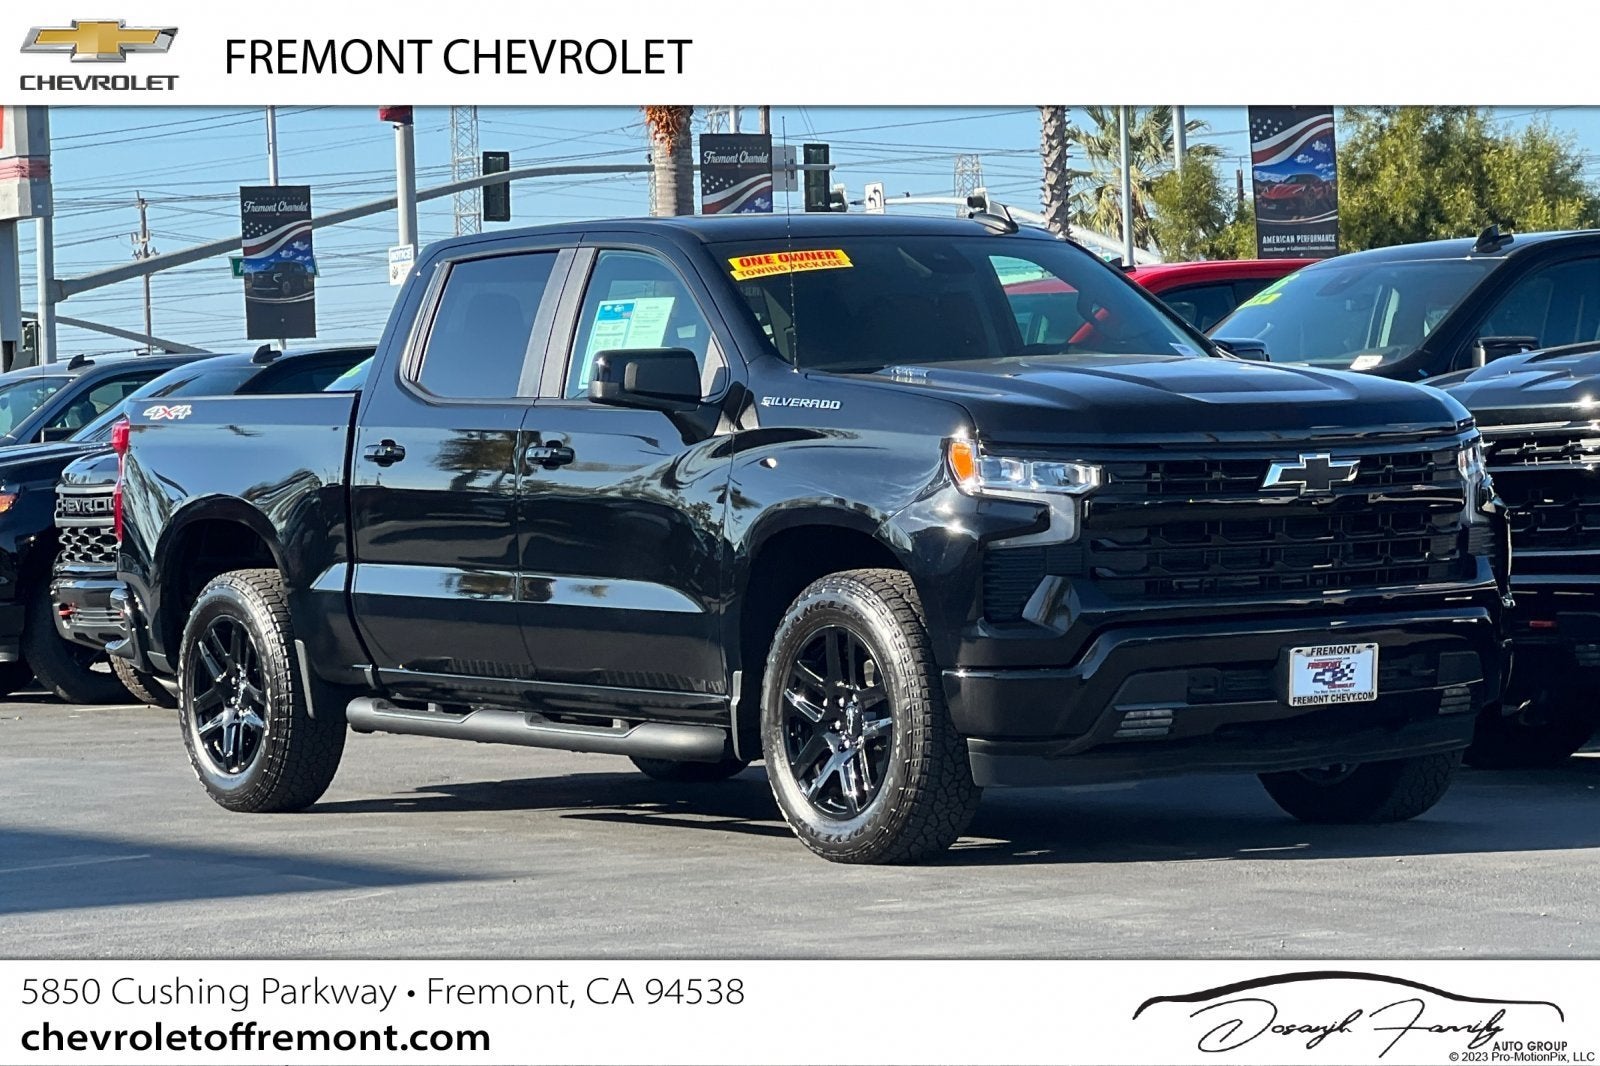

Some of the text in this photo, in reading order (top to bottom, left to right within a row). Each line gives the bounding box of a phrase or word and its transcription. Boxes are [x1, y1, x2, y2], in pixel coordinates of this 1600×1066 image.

[704, 150, 738, 164] Fremont
[244, 201, 277, 213] Fremont
[1262, 234, 1336, 244] AMERICAN PERFORMANCE
[739, 251, 837, 268] ONE OWNER
[738, 259, 845, 278] TOWING PACKAGE
[761, 396, 842, 410] SILVERADO
[1310, 645, 1357, 656] FREMONT
[1293, 691, 1375, 705] FREMONT CHEVY.COM
